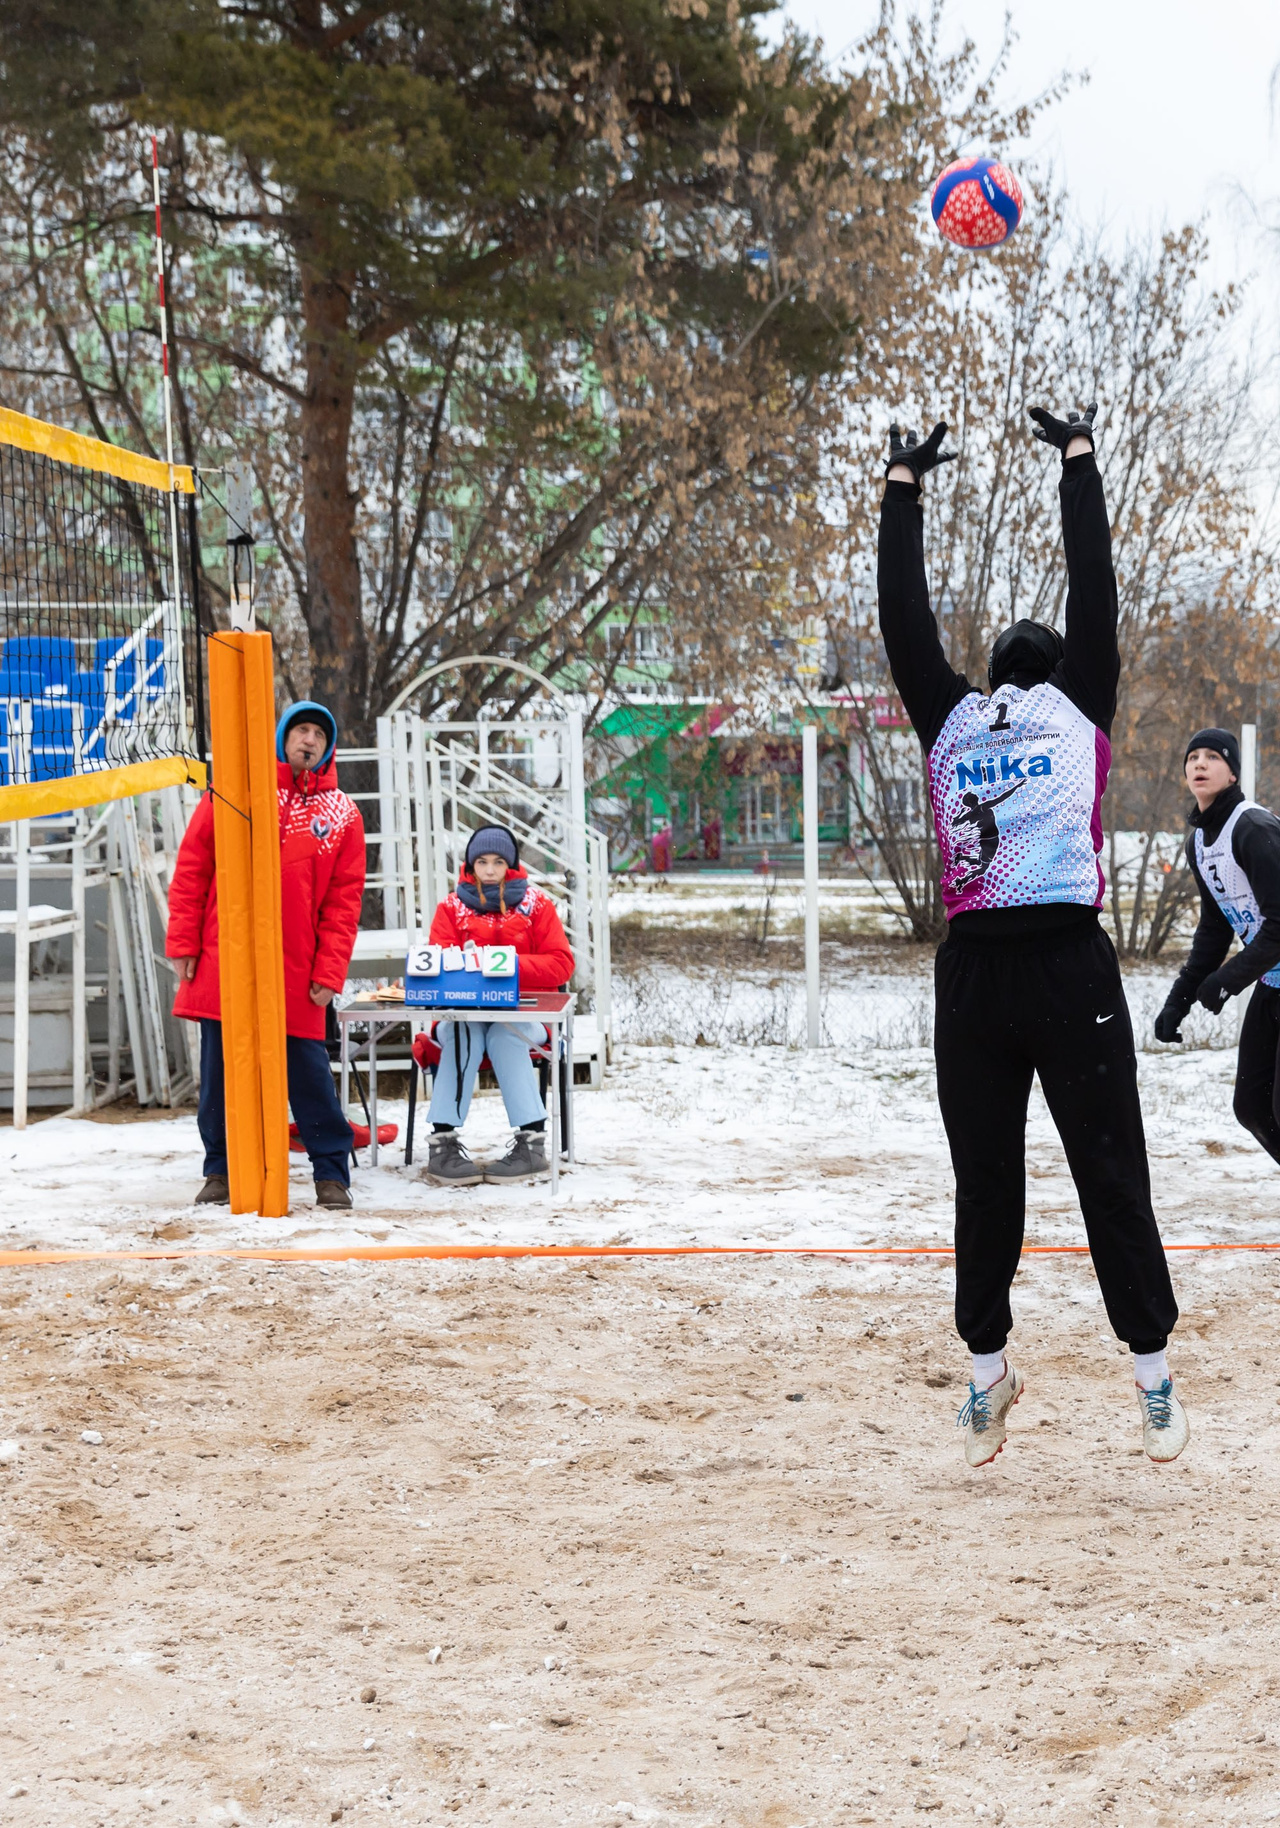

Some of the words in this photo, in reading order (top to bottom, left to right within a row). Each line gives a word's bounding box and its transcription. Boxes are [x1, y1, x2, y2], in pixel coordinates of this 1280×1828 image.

[989, 702, 1011, 732] 1
[985, 738, 1024, 748] ВОЛЕЙБОЛА
[1024, 733, 1060, 742] УДМУРТИИ
[956, 755, 1053, 791] Nika
[1209, 864, 1226, 893] 3
[415, 951, 433, 971] 3
[471, 953, 480, 968] 1
[490, 952, 508, 971] 2
[407, 990, 439, 1000] GUEST
[444, 991, 477, 999] TORRES
[482, 991, 514, 1001] HOME
